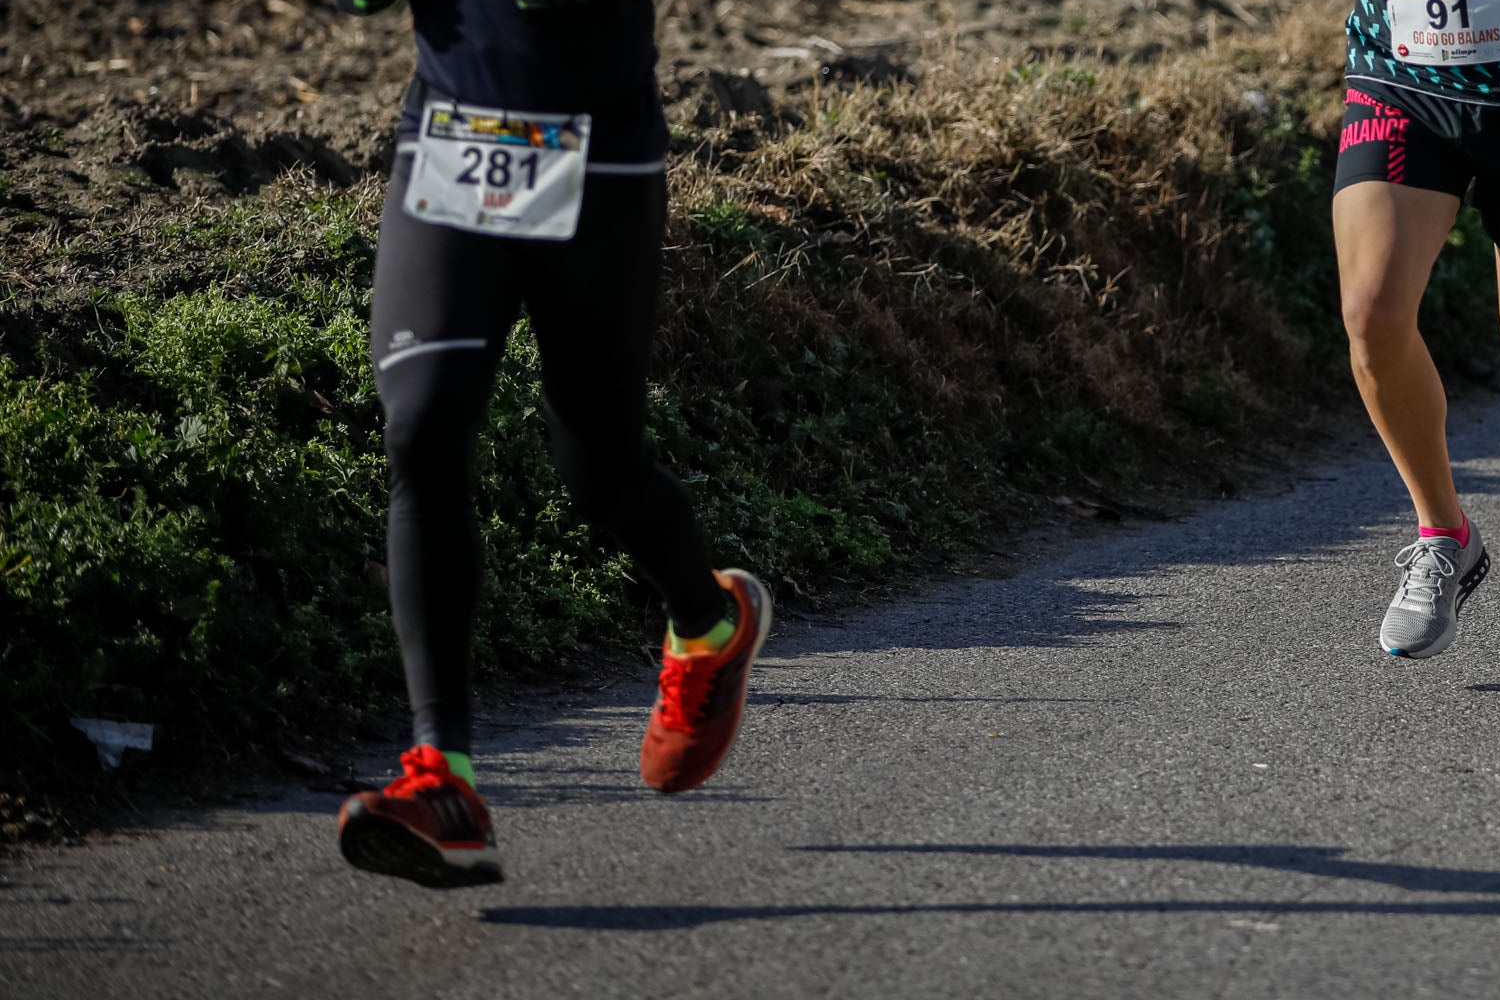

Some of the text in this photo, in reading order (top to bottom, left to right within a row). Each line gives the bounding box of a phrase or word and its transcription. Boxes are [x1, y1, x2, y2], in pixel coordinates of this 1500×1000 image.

[1413, 28, 1500, 46] GO GO GO BALANS
[1339, 118, 1410, 153] BALANCE
[456, 146, 539, 190] 281
